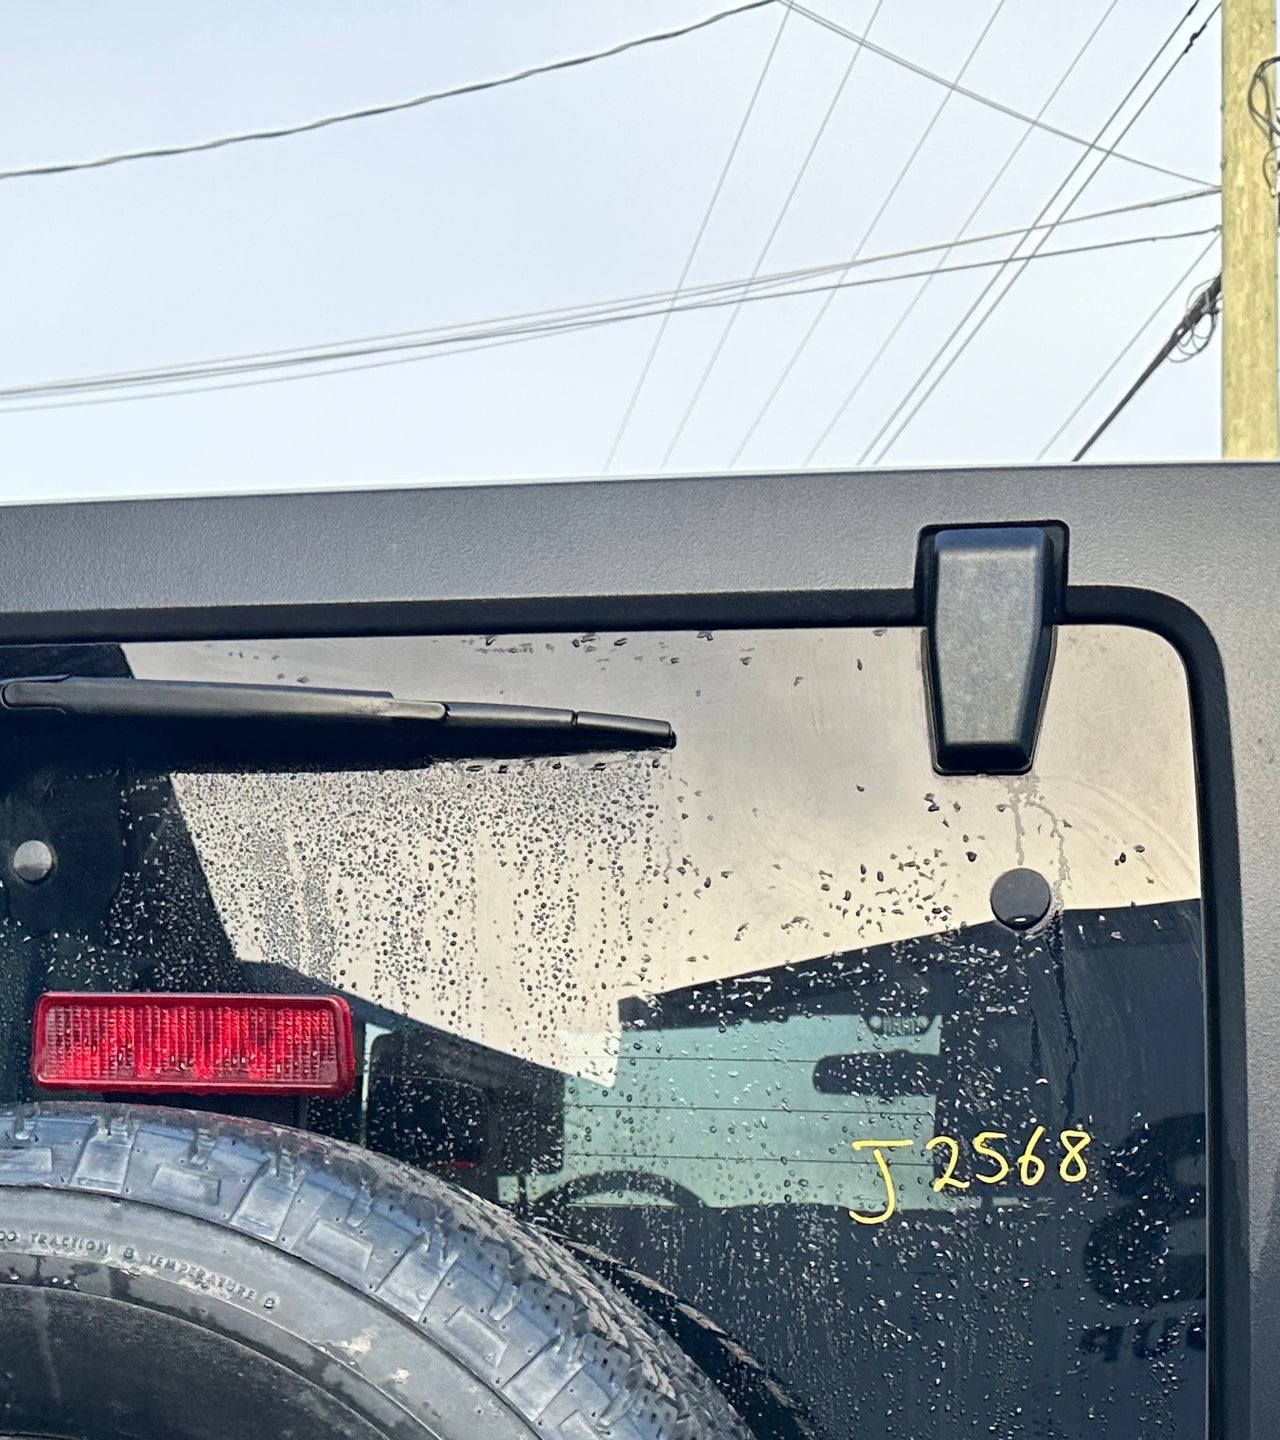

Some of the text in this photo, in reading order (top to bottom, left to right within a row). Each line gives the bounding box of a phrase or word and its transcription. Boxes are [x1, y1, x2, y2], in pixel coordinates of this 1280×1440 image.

[849, 1126, 1091, 1225] J2568
[31, 1232, 110, 1255] TRACTION
[148, 1253, 258, 1301] TEMPERATURE
